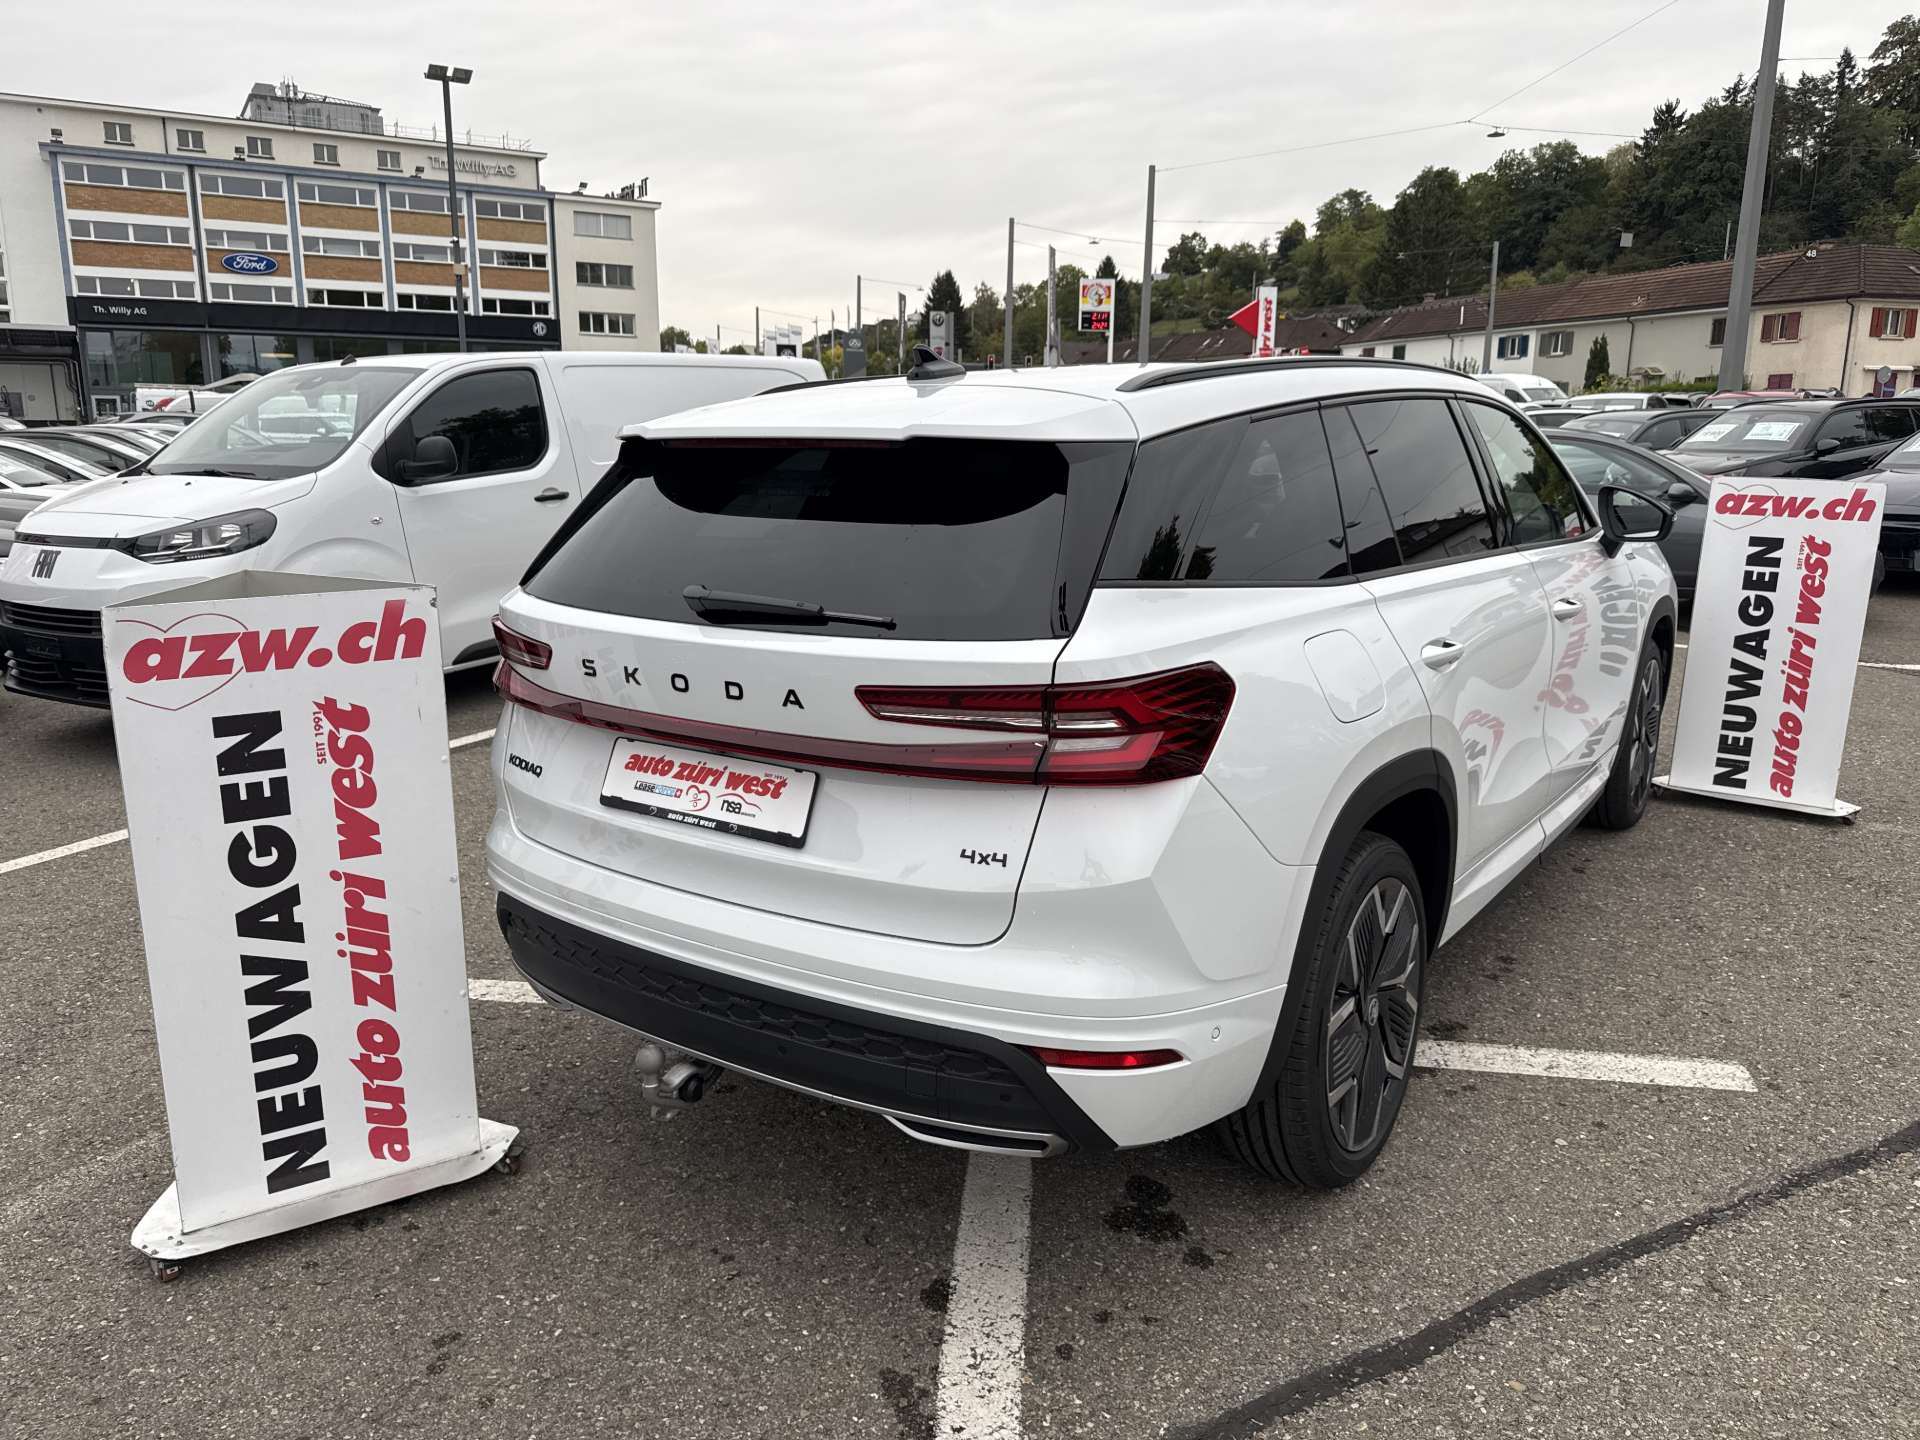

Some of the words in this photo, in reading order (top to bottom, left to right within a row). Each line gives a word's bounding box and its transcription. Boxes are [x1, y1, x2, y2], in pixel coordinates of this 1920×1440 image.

[455, 159, 491, 177] Willy
[495, 163, 517, 177] AG
[233, 255, 268, 270] Ford
[1806, 249, 1817, 258] 48
[93, 305, 107, 313] Th.
[109, 305, 132, 316] Willy
[133, 307, 147, 315] AG
[1715, 488, 1877, 522] azw.ch
[1795, 534, 1832, 625] west
[122, 599, 427, 684] azw.ch
[1712, 535, 1785, 790] NEUWAGEN
[1780, 626, 1817, 713] züri
[581, 658, 805, 710] SKODA
[313, 711, 324, 737] 1991
[316, 741, 327, 764] SEIT
[508, 752, 543, 778] KODIAQ
[1770, 711, 1803, 798] auto
[312, 696, 382, 860] west
[624, 753, 675, 778] auto
[672, 761, 728, 788] züri
[723, 770, 788, 799] west
[667, 812, 684, 821] auto
[721, 799, 742, 814] nsa
[959, 848, 1008, 868] 4x4
[211, 710, 331, 1195] NEUWAGEN
[329, 870, 397, 1011] züri
[349, 1019, 411, 1162] auto
